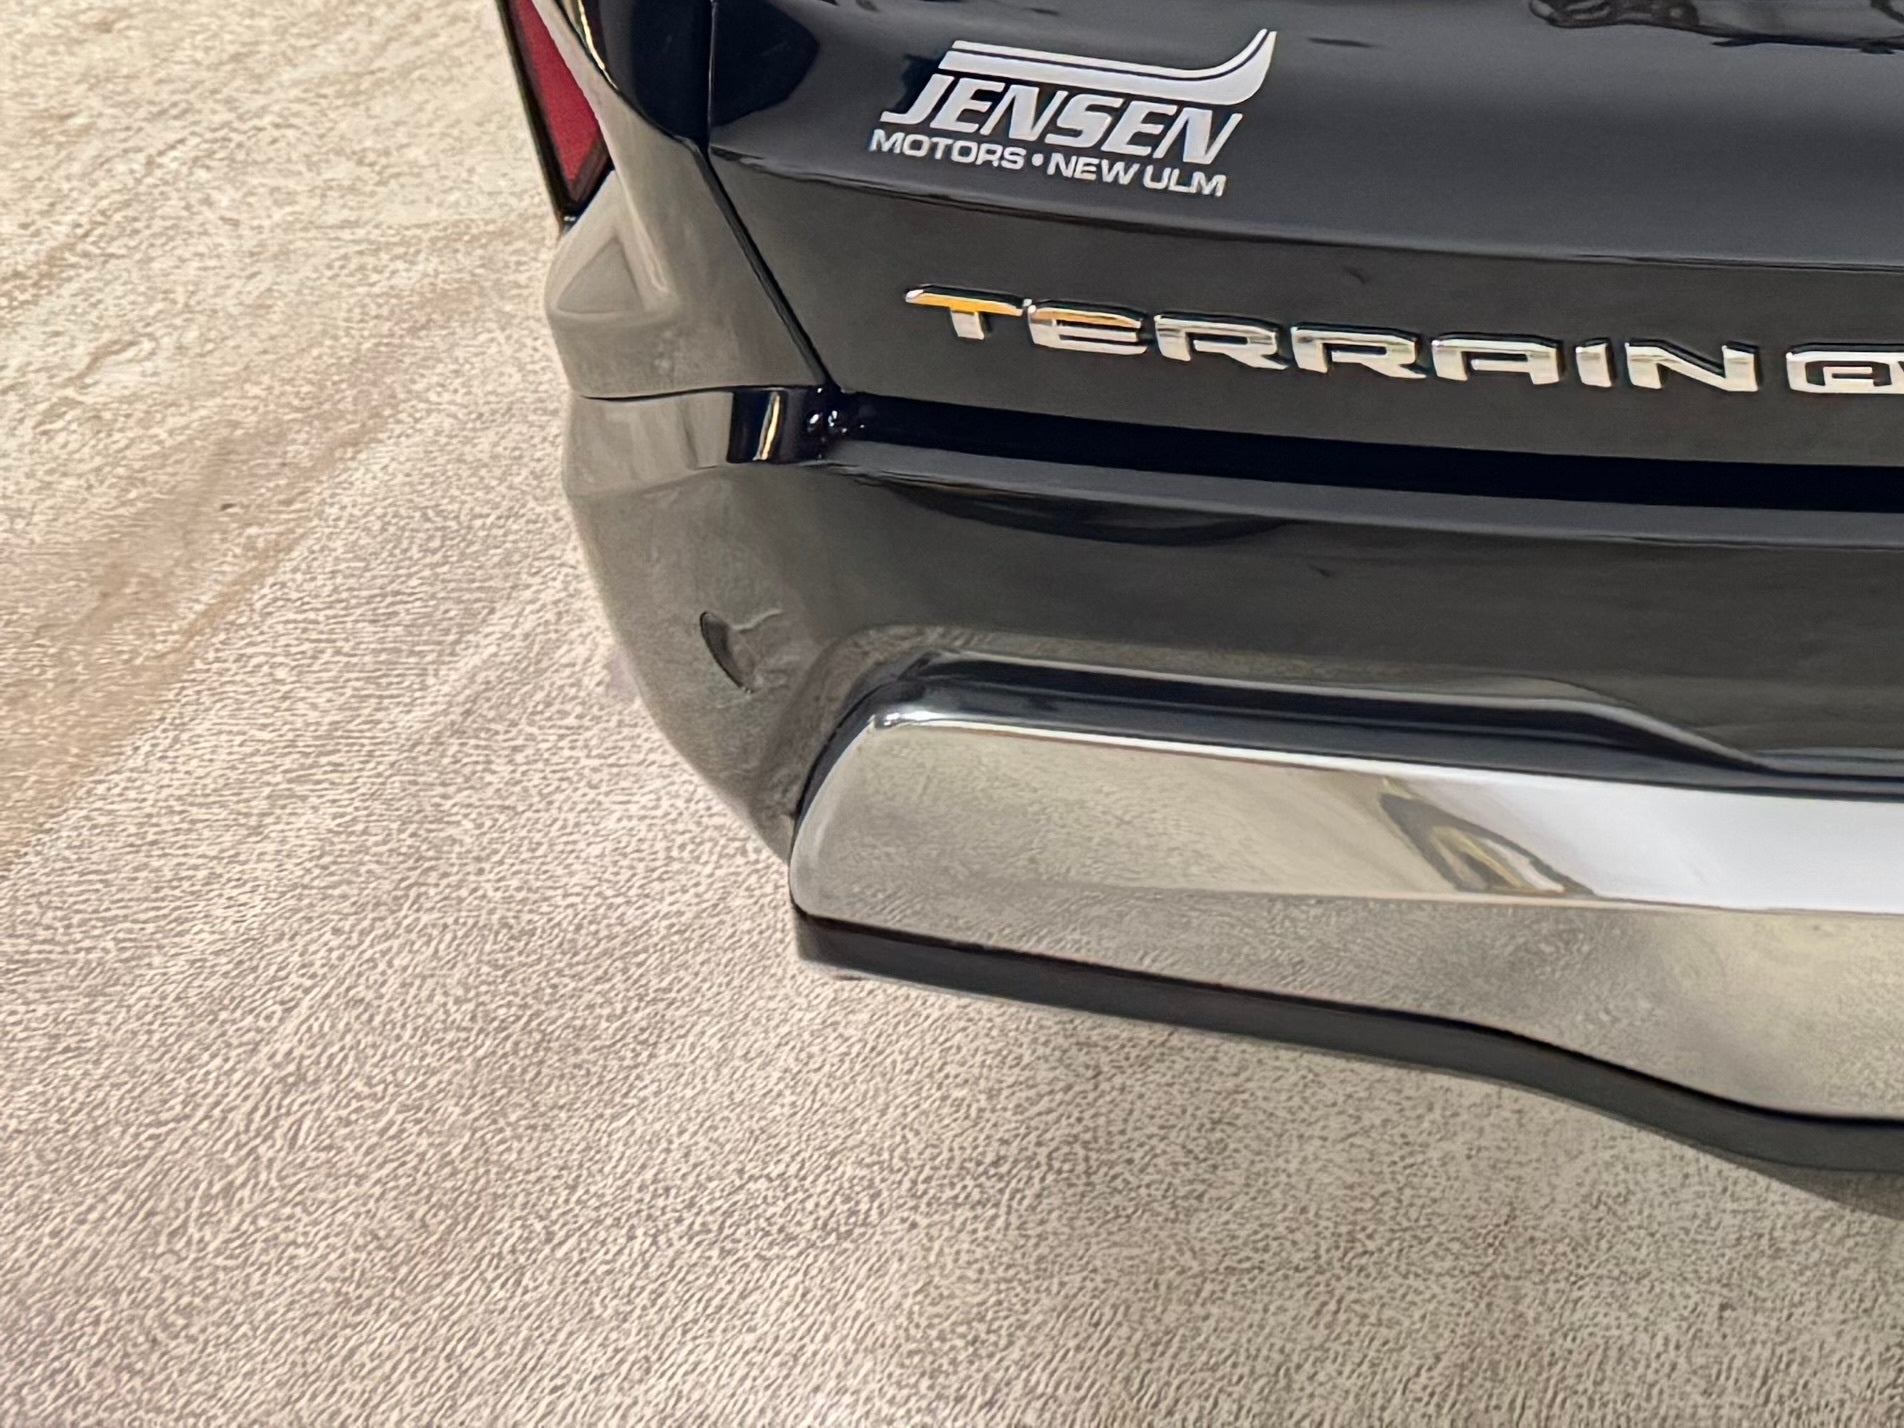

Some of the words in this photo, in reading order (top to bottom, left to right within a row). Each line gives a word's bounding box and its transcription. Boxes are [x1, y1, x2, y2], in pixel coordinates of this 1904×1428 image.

[869, 128, 1027, 170] MOTORS
[1047, 152, 1140, 186] NEW
[1142, 166, 1228, 198] ULM
[880, 73, 1243, 165] JENSEN
[905, 286, 1760, 394] TERRAIN
